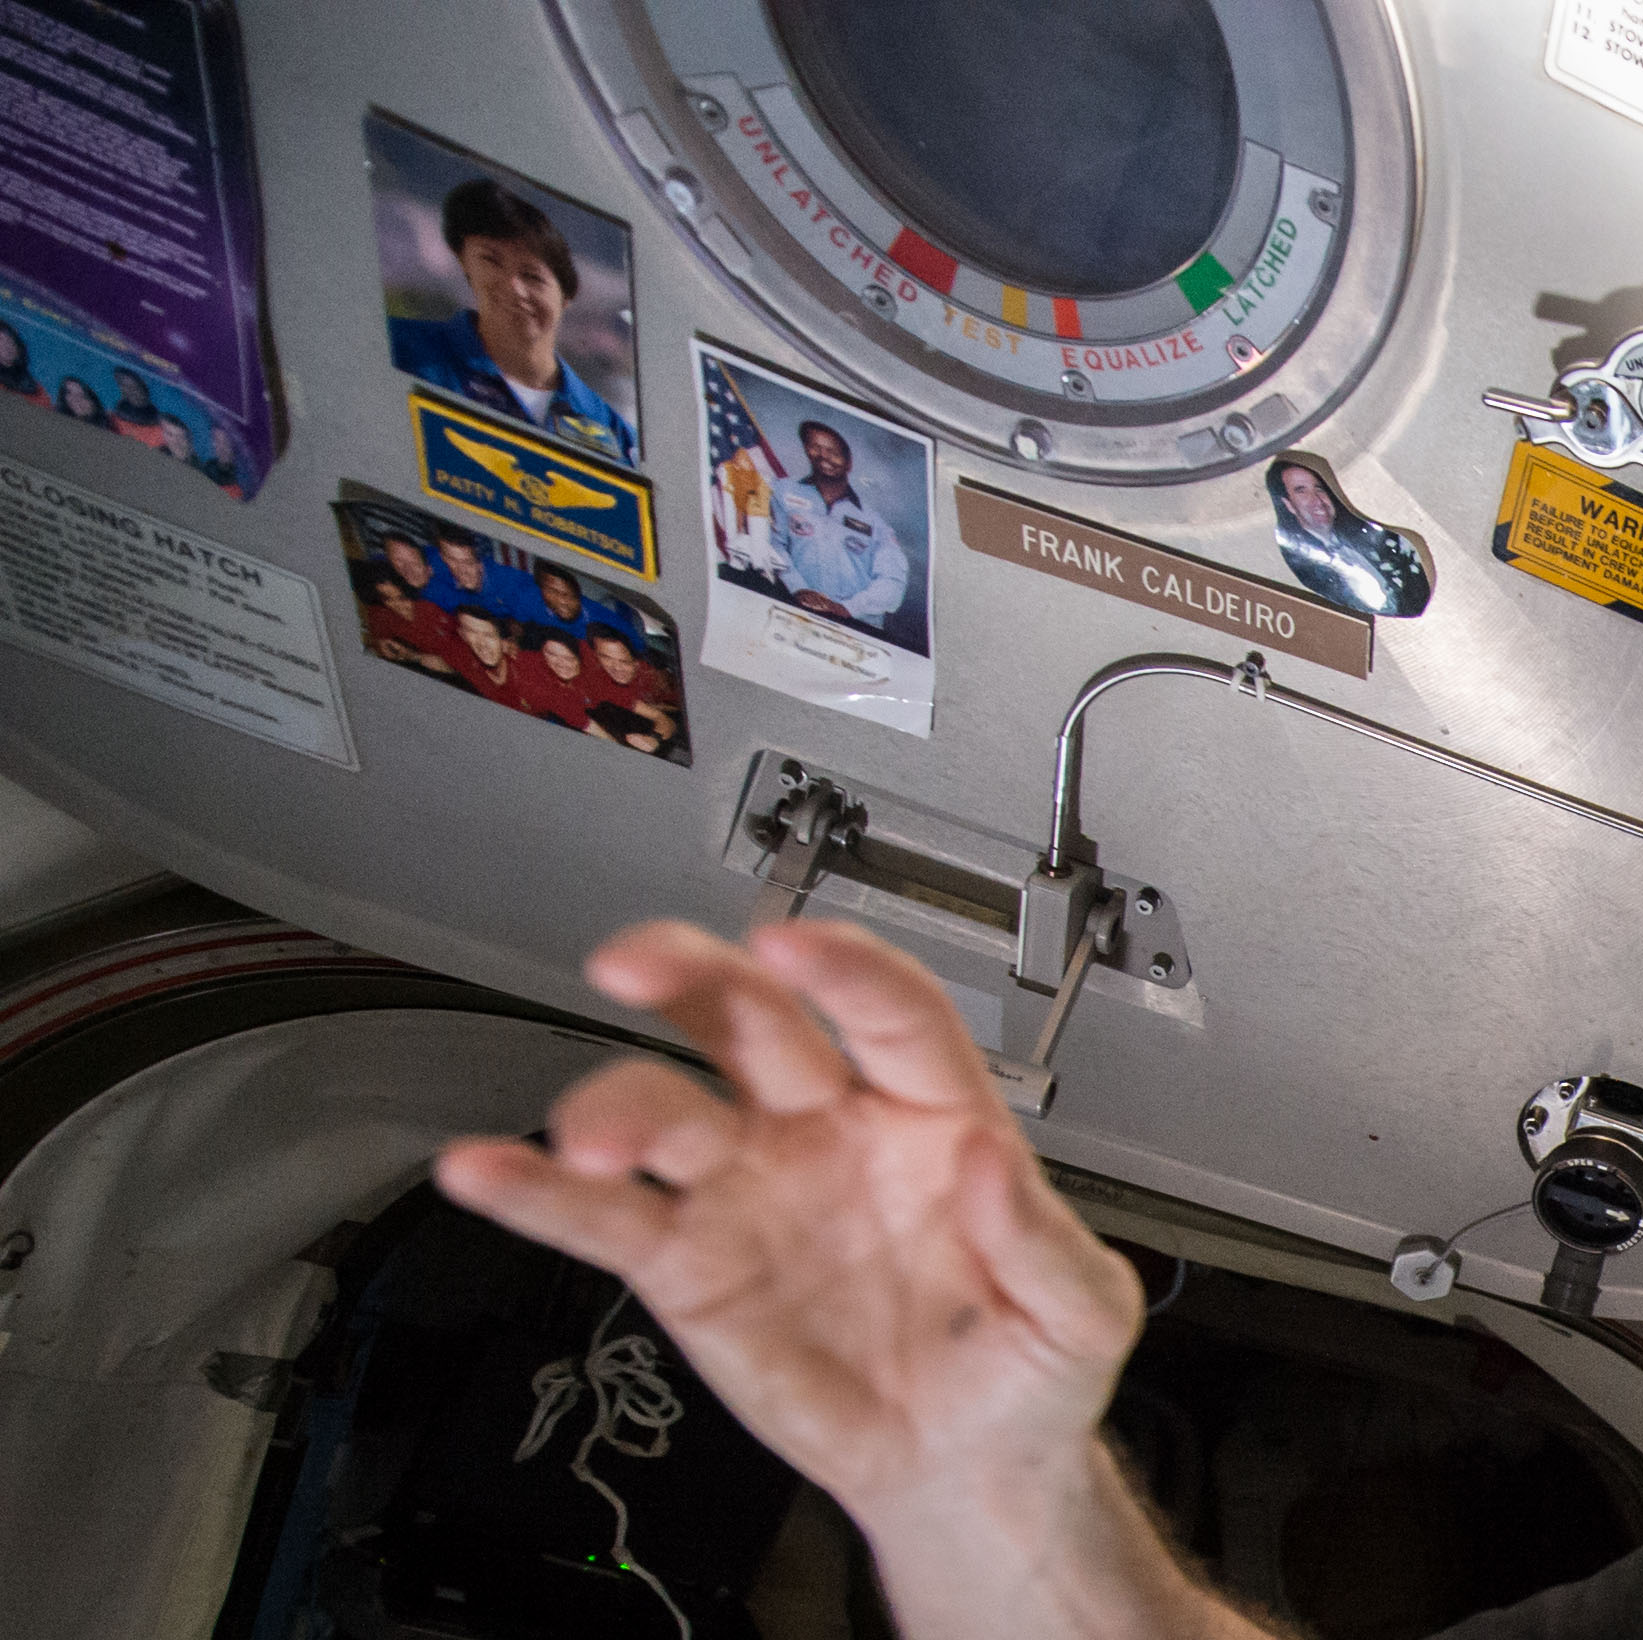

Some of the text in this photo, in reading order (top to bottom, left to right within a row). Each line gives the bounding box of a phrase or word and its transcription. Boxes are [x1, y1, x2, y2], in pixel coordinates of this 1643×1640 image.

[737, 115, 919, 304] UNLATCHED
[1221, 216, 1299, 328] LATCHED
[943, 303, 1023, 356] TEST
[1061, 330, 1205, 373] EQUALIZE
[1, 467, 263, 587] CLOSING HATCH
[1528, 510, 1583, 543] BEFORE
[1531, 498, 1585, 531] FAILURE
[1591, 525, 1607, 539] TO
[1524, 533, 1599, 573] EQUIPMENT
[1526, 522, 1579, 554] RESULT
[1581, 546, 1595, 560] IN
[1599, 554, 1637, 580] CREW
[1021, 523, 1296, 639] FRANK CALDEIRO
